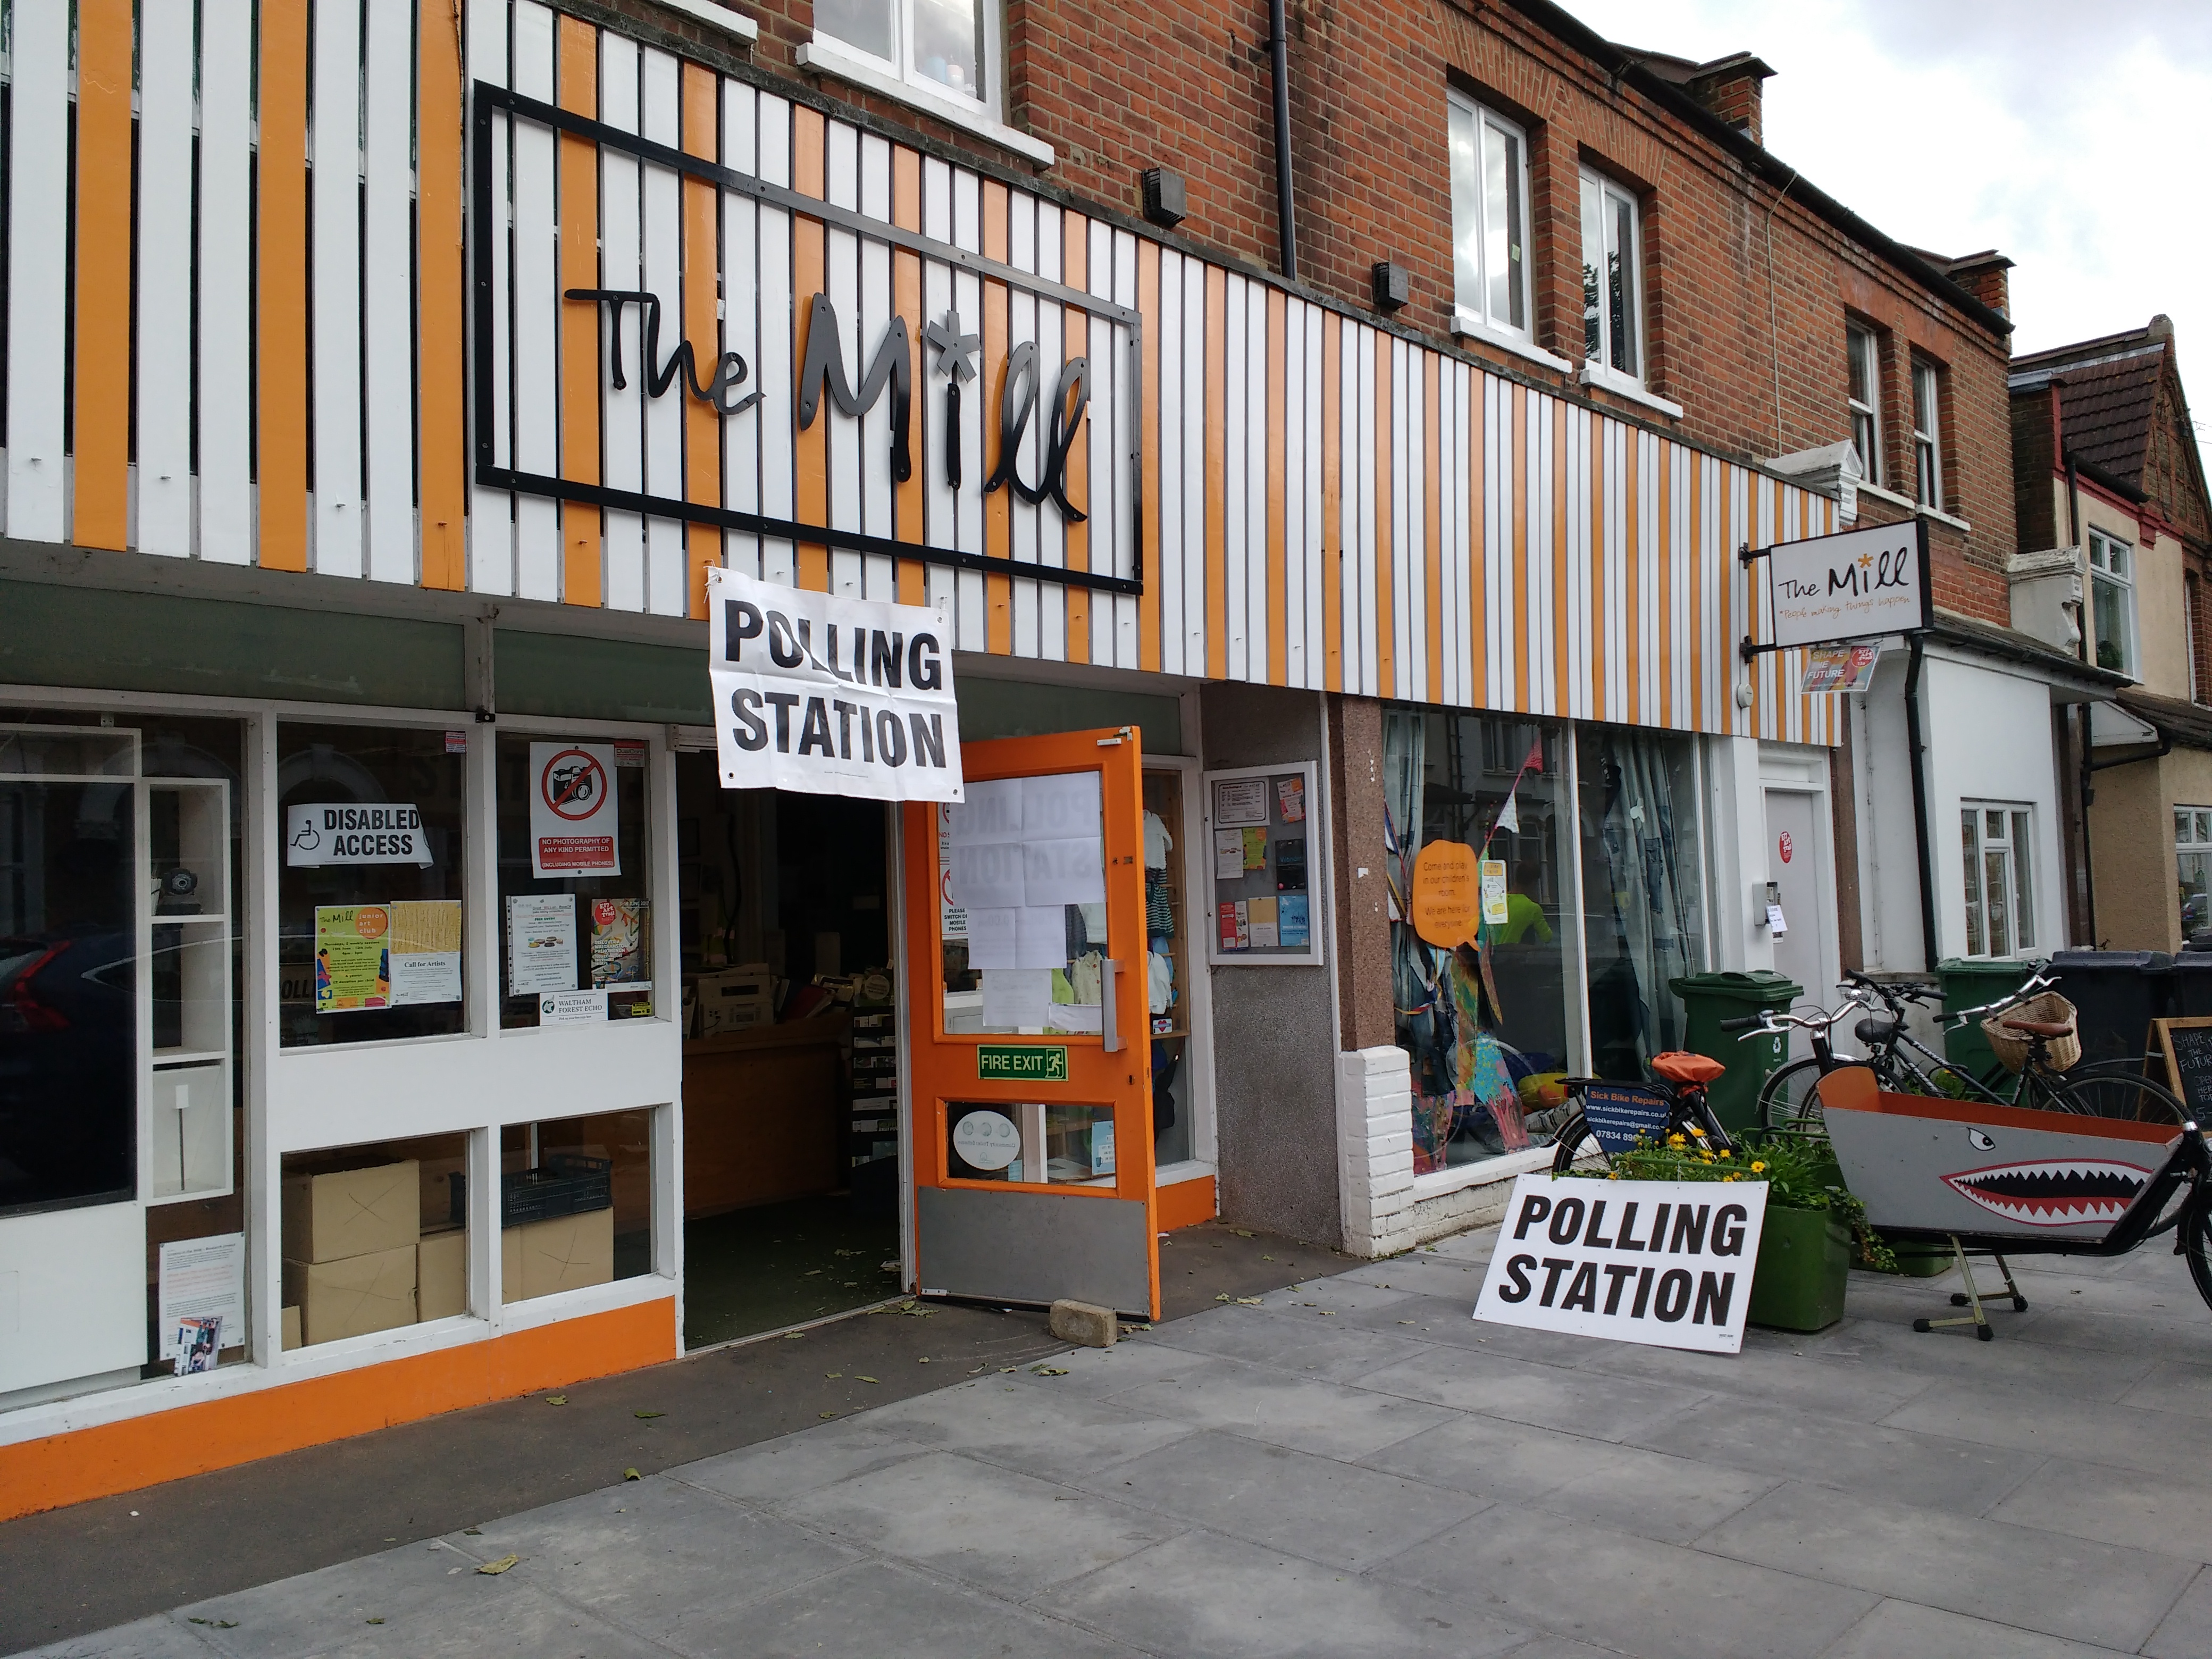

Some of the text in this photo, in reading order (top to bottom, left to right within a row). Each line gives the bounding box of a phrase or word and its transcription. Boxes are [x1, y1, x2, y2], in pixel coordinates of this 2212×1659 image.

[564, 289, 1087, 522] The Mill
[1778, 547, 1909, 599] The Mill
[1811, 606, 1841, 619] making
[1845, 599, 1874, 614] things
[1878, 596, 1911, 609] happen
[725, 599, 942, 690] POLLING
[1813, 649, 1845, 659] SHAPE
[1807, 669, 1845, 678] FUTURE
[732, 689, 946, 768] STATION
[324, 809, 419, 830] DISABLED
[333, 834, 413, 856] ACCESS
[1423, 861, 1468, 871] Come and play
[332, 910, 354, 923] Mill
[1425, 907, 1435, 915] We
[2173, 1032, 2205, 1051] SHAPE
[2188, 1048, 2204, 1057] THE
[981, 1055, 1043, 1070] FIRE EXIT
[1590, 1091, 1664, 1106] Sick Bike Repairs
[1596, 1129, 1621, 1140] 07834
[1513, 1194, 1748, 1256] POLLING
[1498, 1254, 1736, 1326] STATION
